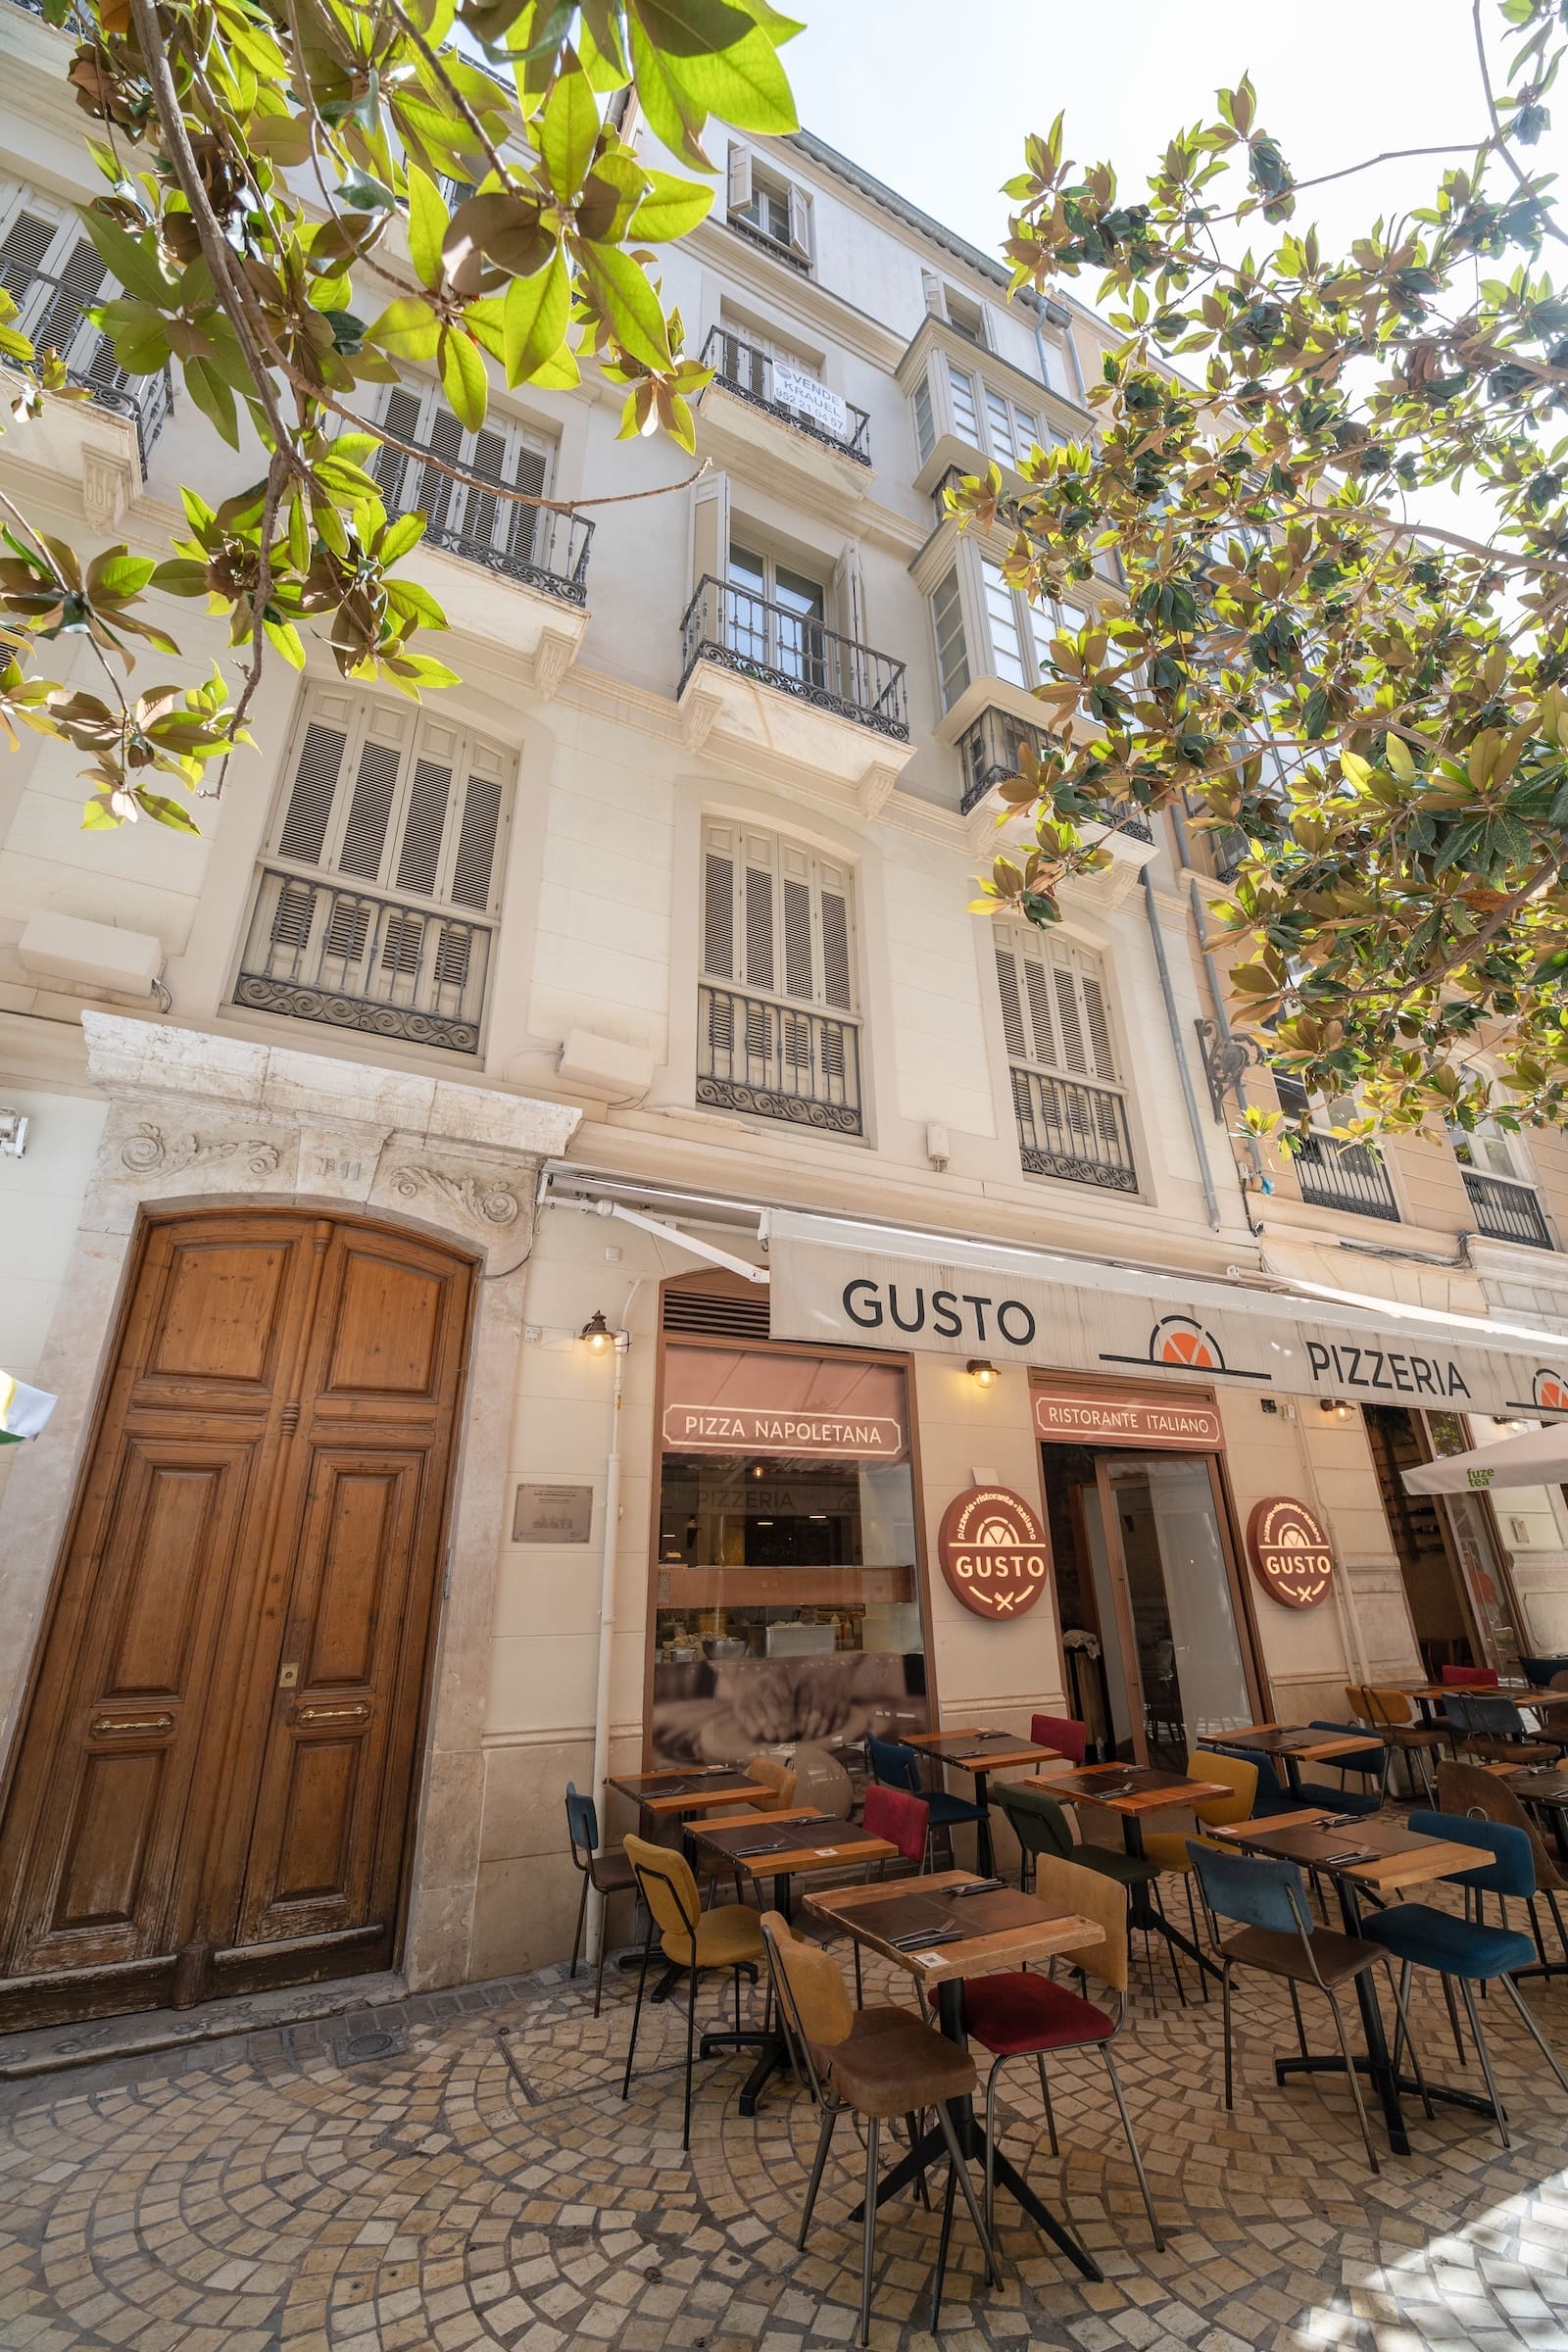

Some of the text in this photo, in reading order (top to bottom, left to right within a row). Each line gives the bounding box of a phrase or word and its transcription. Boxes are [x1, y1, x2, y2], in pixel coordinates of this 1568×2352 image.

[784, 380, 841, 417] KRAUEL
[792, 373, 840, 406] VENDE
[776, 387, 797, 405] 952
[800, 400, 811, 413] 21
[830, 417, 844, 429] 57
[842, 1279, 1036, 1346] GUSTO
[1305, 1341, 1472, 1398] PIZZERIA
[685, 1416, 882, 1444] PIZZA NAPOLETANA
[1049, 1406, 1209, 1433] RISTORANTE ITALIANO
[1466, 1468, 1494, 1480] fuze
[1469, 1477, 1490, 1488] tea
[957, 1493, 1036, 1541] pizzeria ristorante italiano
[956, 1555, 1045, 1578] GUSTO
[1266, 1556, 1331, 1574] GUSTO
